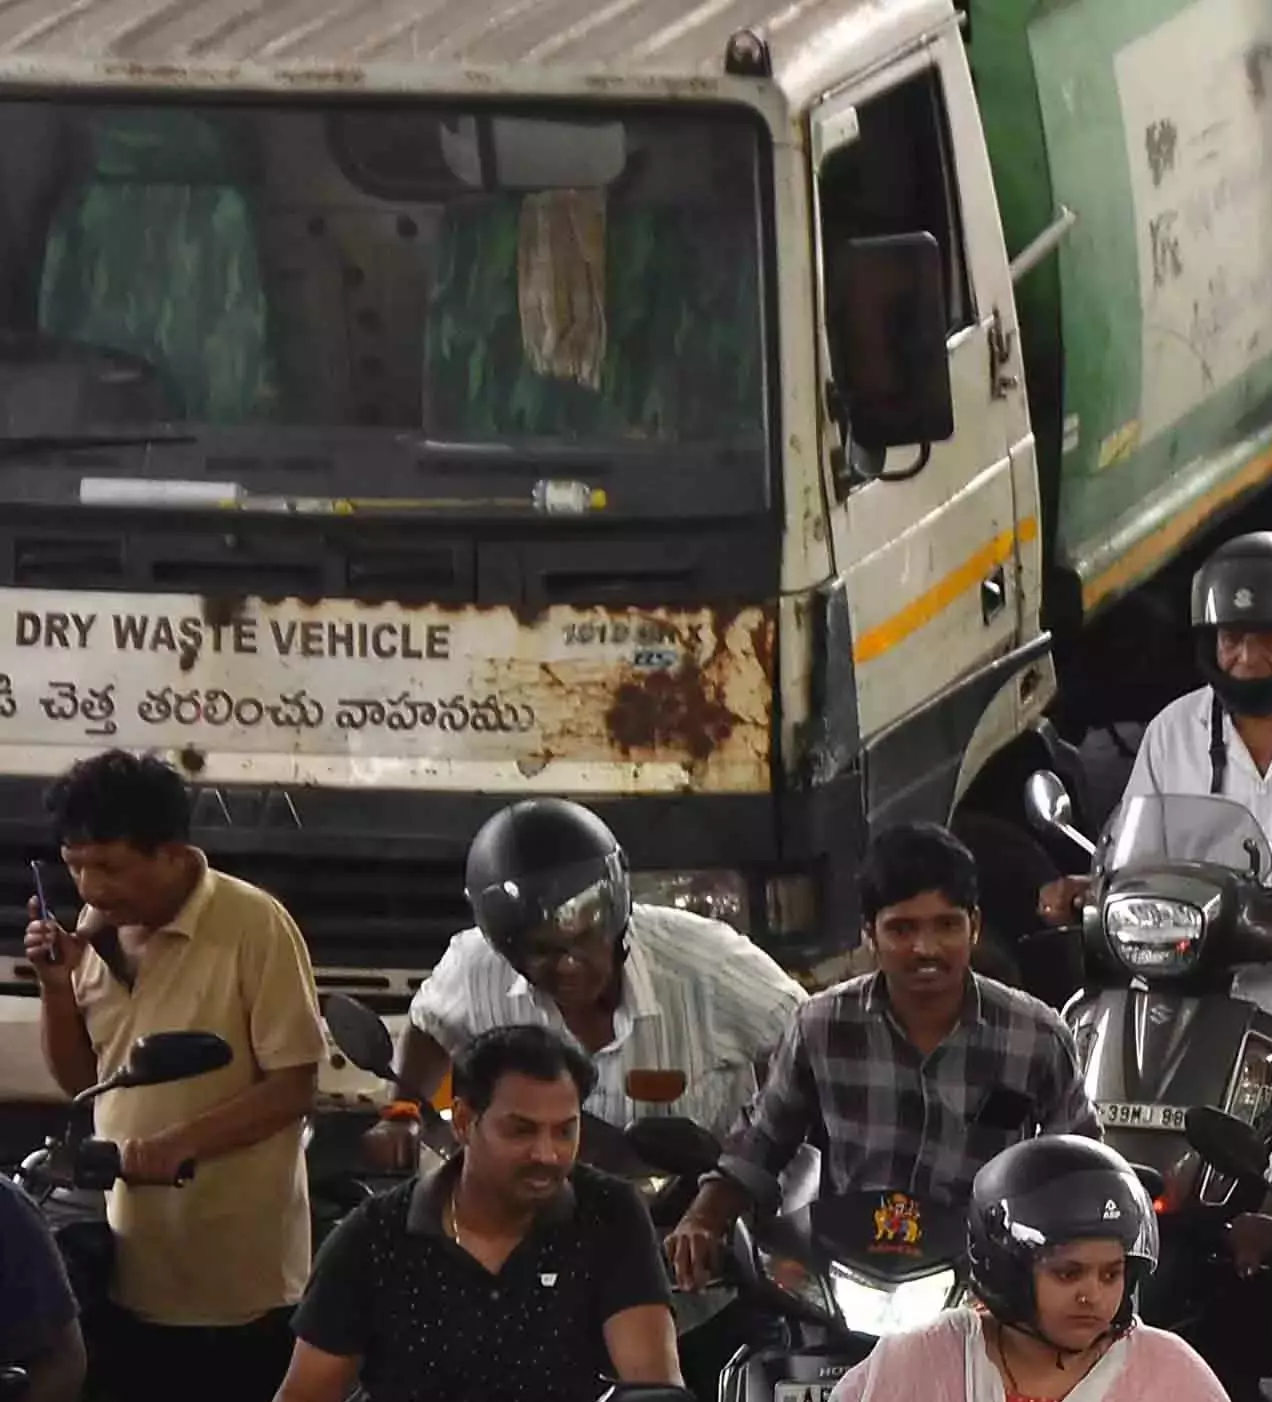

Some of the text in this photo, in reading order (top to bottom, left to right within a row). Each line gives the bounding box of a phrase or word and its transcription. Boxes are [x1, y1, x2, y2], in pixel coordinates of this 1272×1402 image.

[16, 611, 451, 660] DRY WASTE VEHICLE
[39, 682, 118, 735] చెత్త
